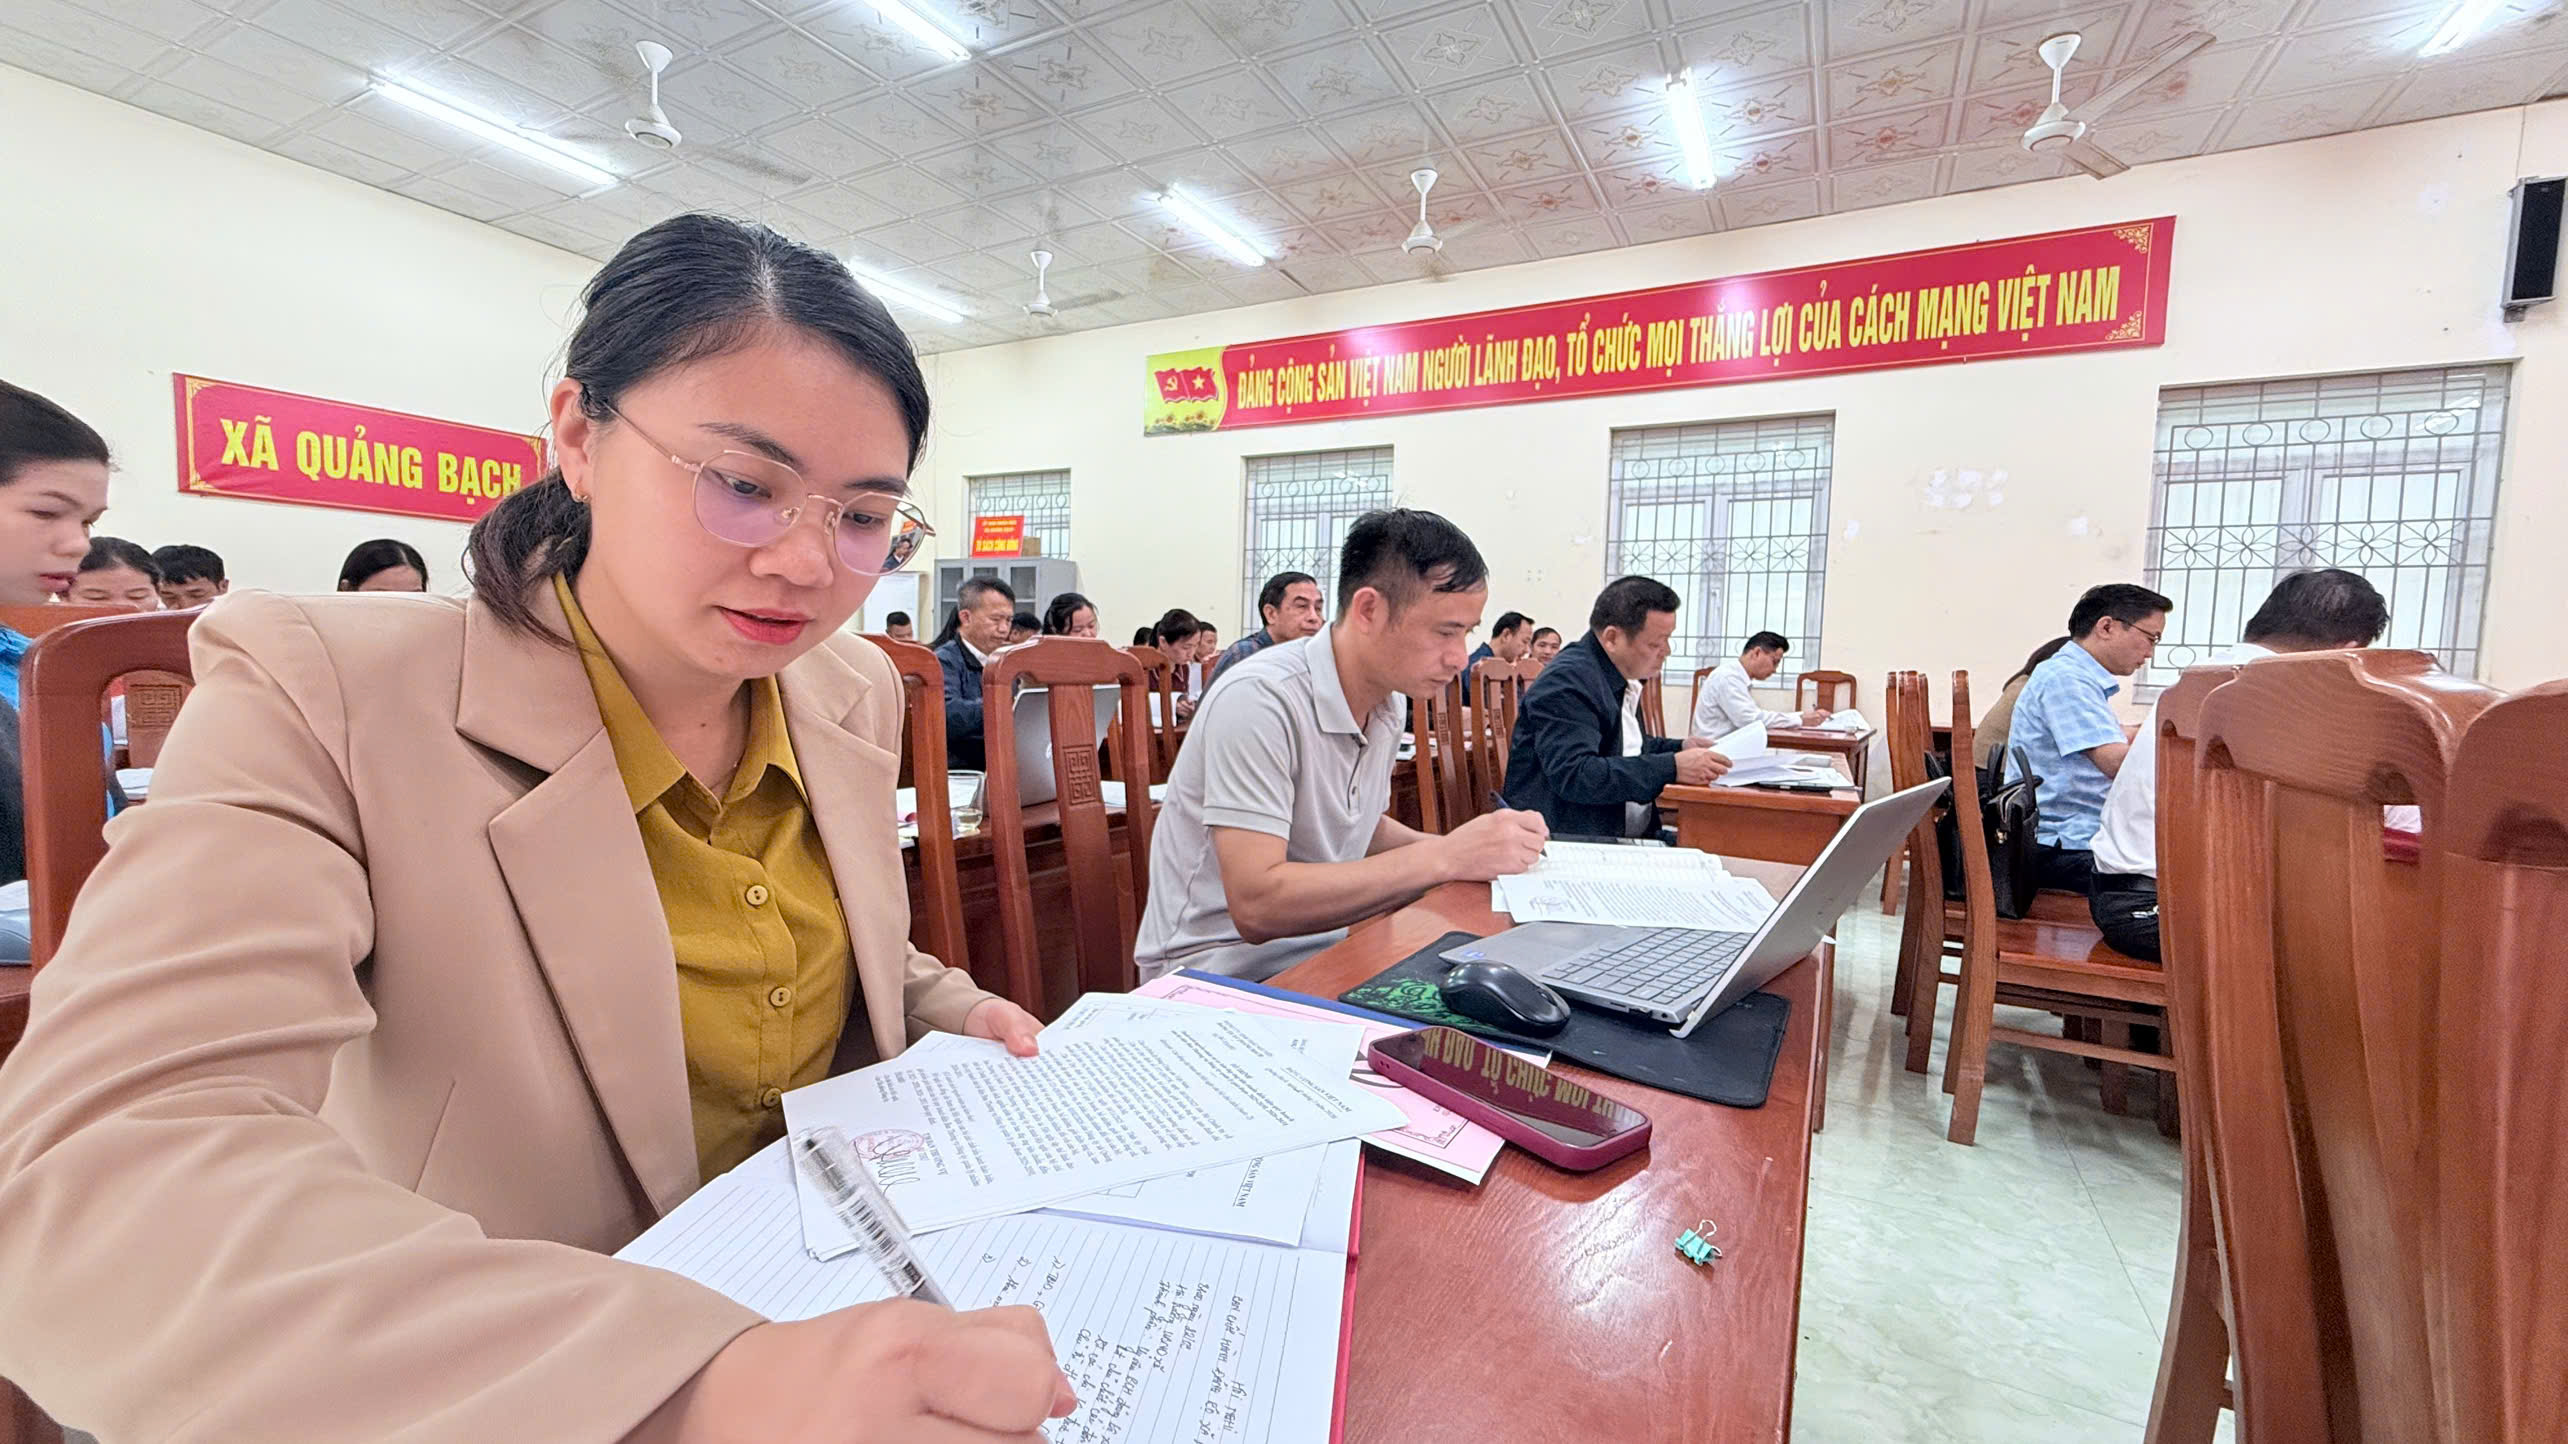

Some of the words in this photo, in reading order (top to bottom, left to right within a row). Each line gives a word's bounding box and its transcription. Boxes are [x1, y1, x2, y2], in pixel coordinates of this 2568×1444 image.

[1237, 354, 1273, 410] ĐẢNG
[1276, 363, 1315, 413] CỘNG
[1316, 342, 1347, 401] SẢN
[1348, 351, 1381, 406] VIỆT
[1382, 351, 1418, 394] NAM
[1422, 335, 1470, 393] NGƯỜI
[1474, 335, 1517, 387] LÃNH
[1521, 335, 1561, 391] ĐẠO,
[1566, 312, 1588, 377] TỔ
[1592, 309, 1641, 373] CHỨC
[1645, 318, 1683, 377] MỌI
[1689, 300, 1754, 364] THẮNG
[1759, 303, 1793, 366] LỢI
[1798, 280, 1842, 353] CỦA
[1848, 276, 1909, 348] CÁCH
[1915, 279, 1988, 350] MẠNG
[1997, 263, 2051, 341] VIỆT
[2054, 264, 2121, 327] NAM
[220, 415, 279, 471] XÃ
[296, 425, 423, 489] QUẢNG
[437, 451, 522, 505] BẠCH
